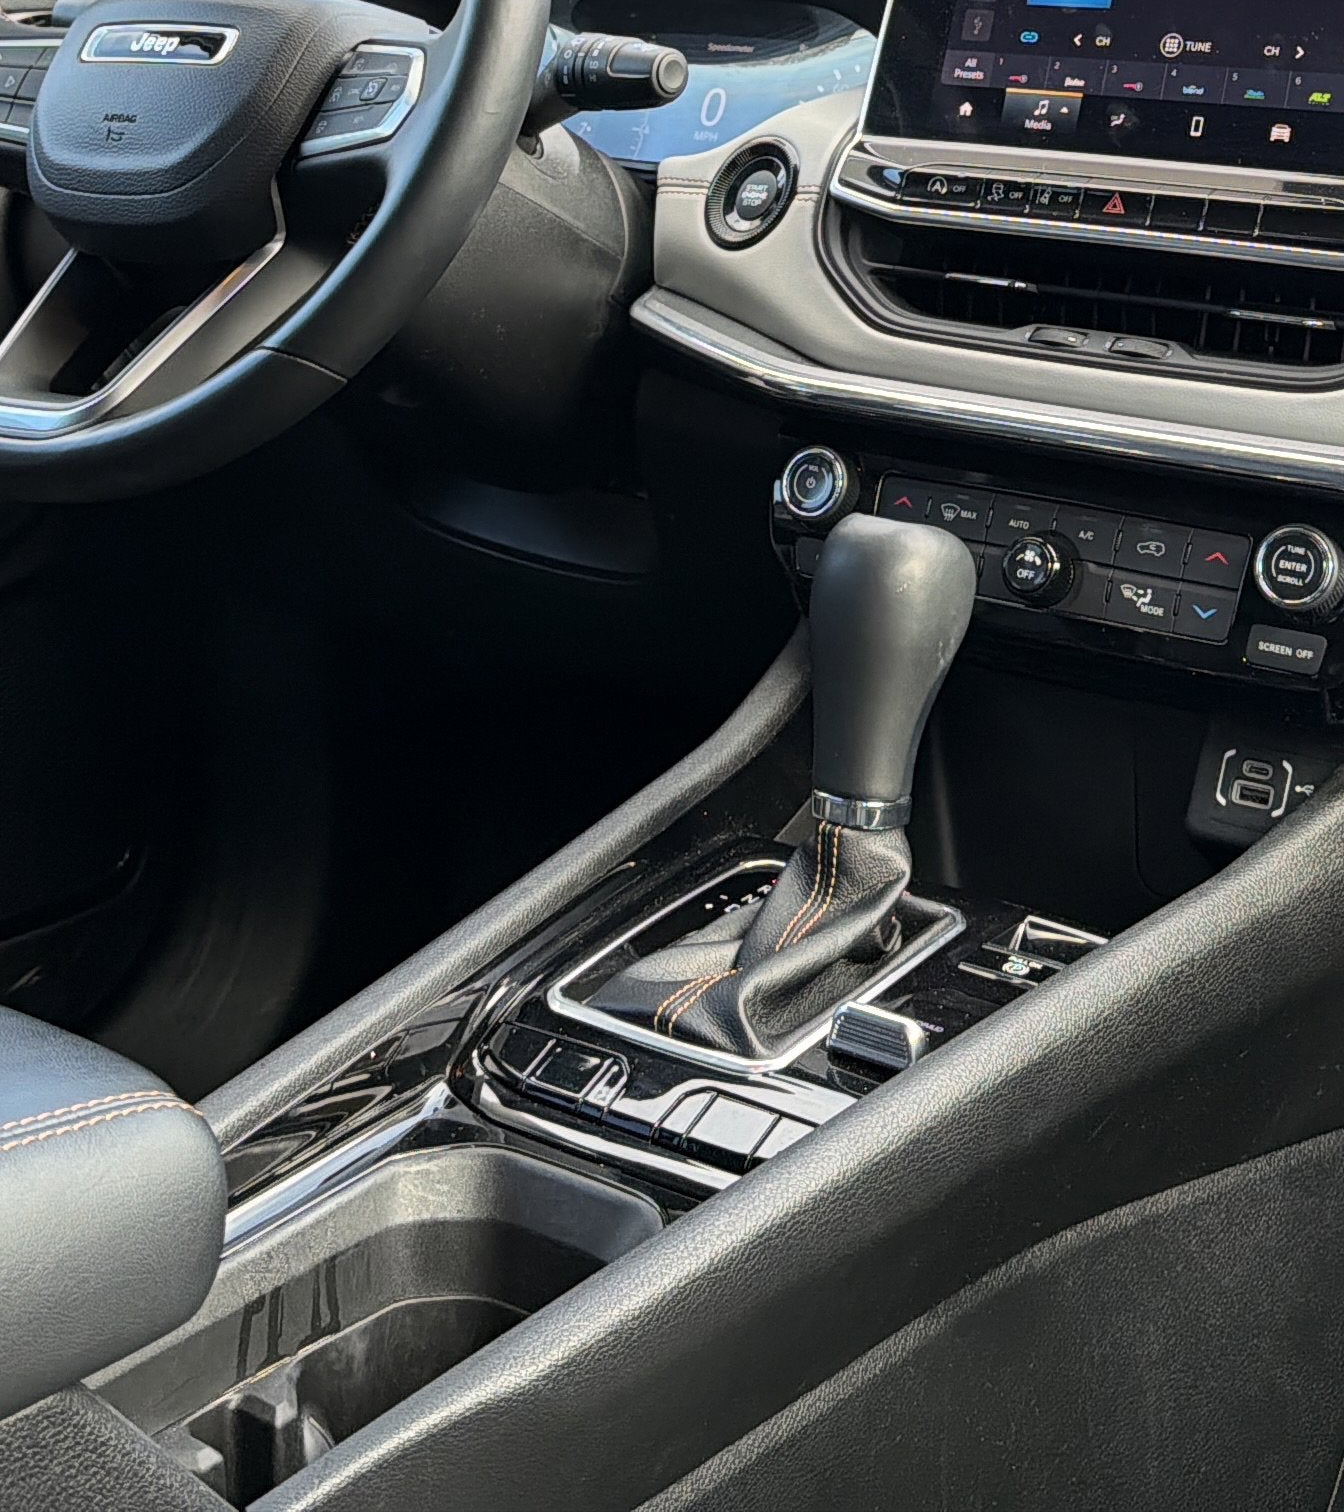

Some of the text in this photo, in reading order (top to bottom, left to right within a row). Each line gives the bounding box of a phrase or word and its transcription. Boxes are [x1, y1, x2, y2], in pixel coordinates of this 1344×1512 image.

[130, 32, 180, 56] Jeep
[1096, 36, 1111, 47] CH
[1184, 41, 1212, 53] TUNE
[1264, 46, 1280, 57] CH
[965, 58, 977, 67] All
[954, 69, 984, 80] Presets
[700, 88, 727, 127] 0
[103, 113, 137, 124] AIRBAG
[1024, 119, 1052, 130] Media
[693, 130, 718, 142] MPH
[953, 185, 966, 193] OFF
[1009, 191, 1023, 200] OFF
[1058, 195, 1073, 203] OFF
[960, 510, 977, 520] MAX
[1008, 519, 1030, 530] AUTO
[1078, 530, 1095, 541] A/C
[1287, 544, 1306, 556] TUNE
[1279, 559, 1308, 573] ENTER
[1016, 568, 1035, 580] OFF
[1277, 574, 1304, 587] SCROLL
[1140, 604, 1164, 617] MODE
[1258, 641, 1315, 660] SCREEN OFF
